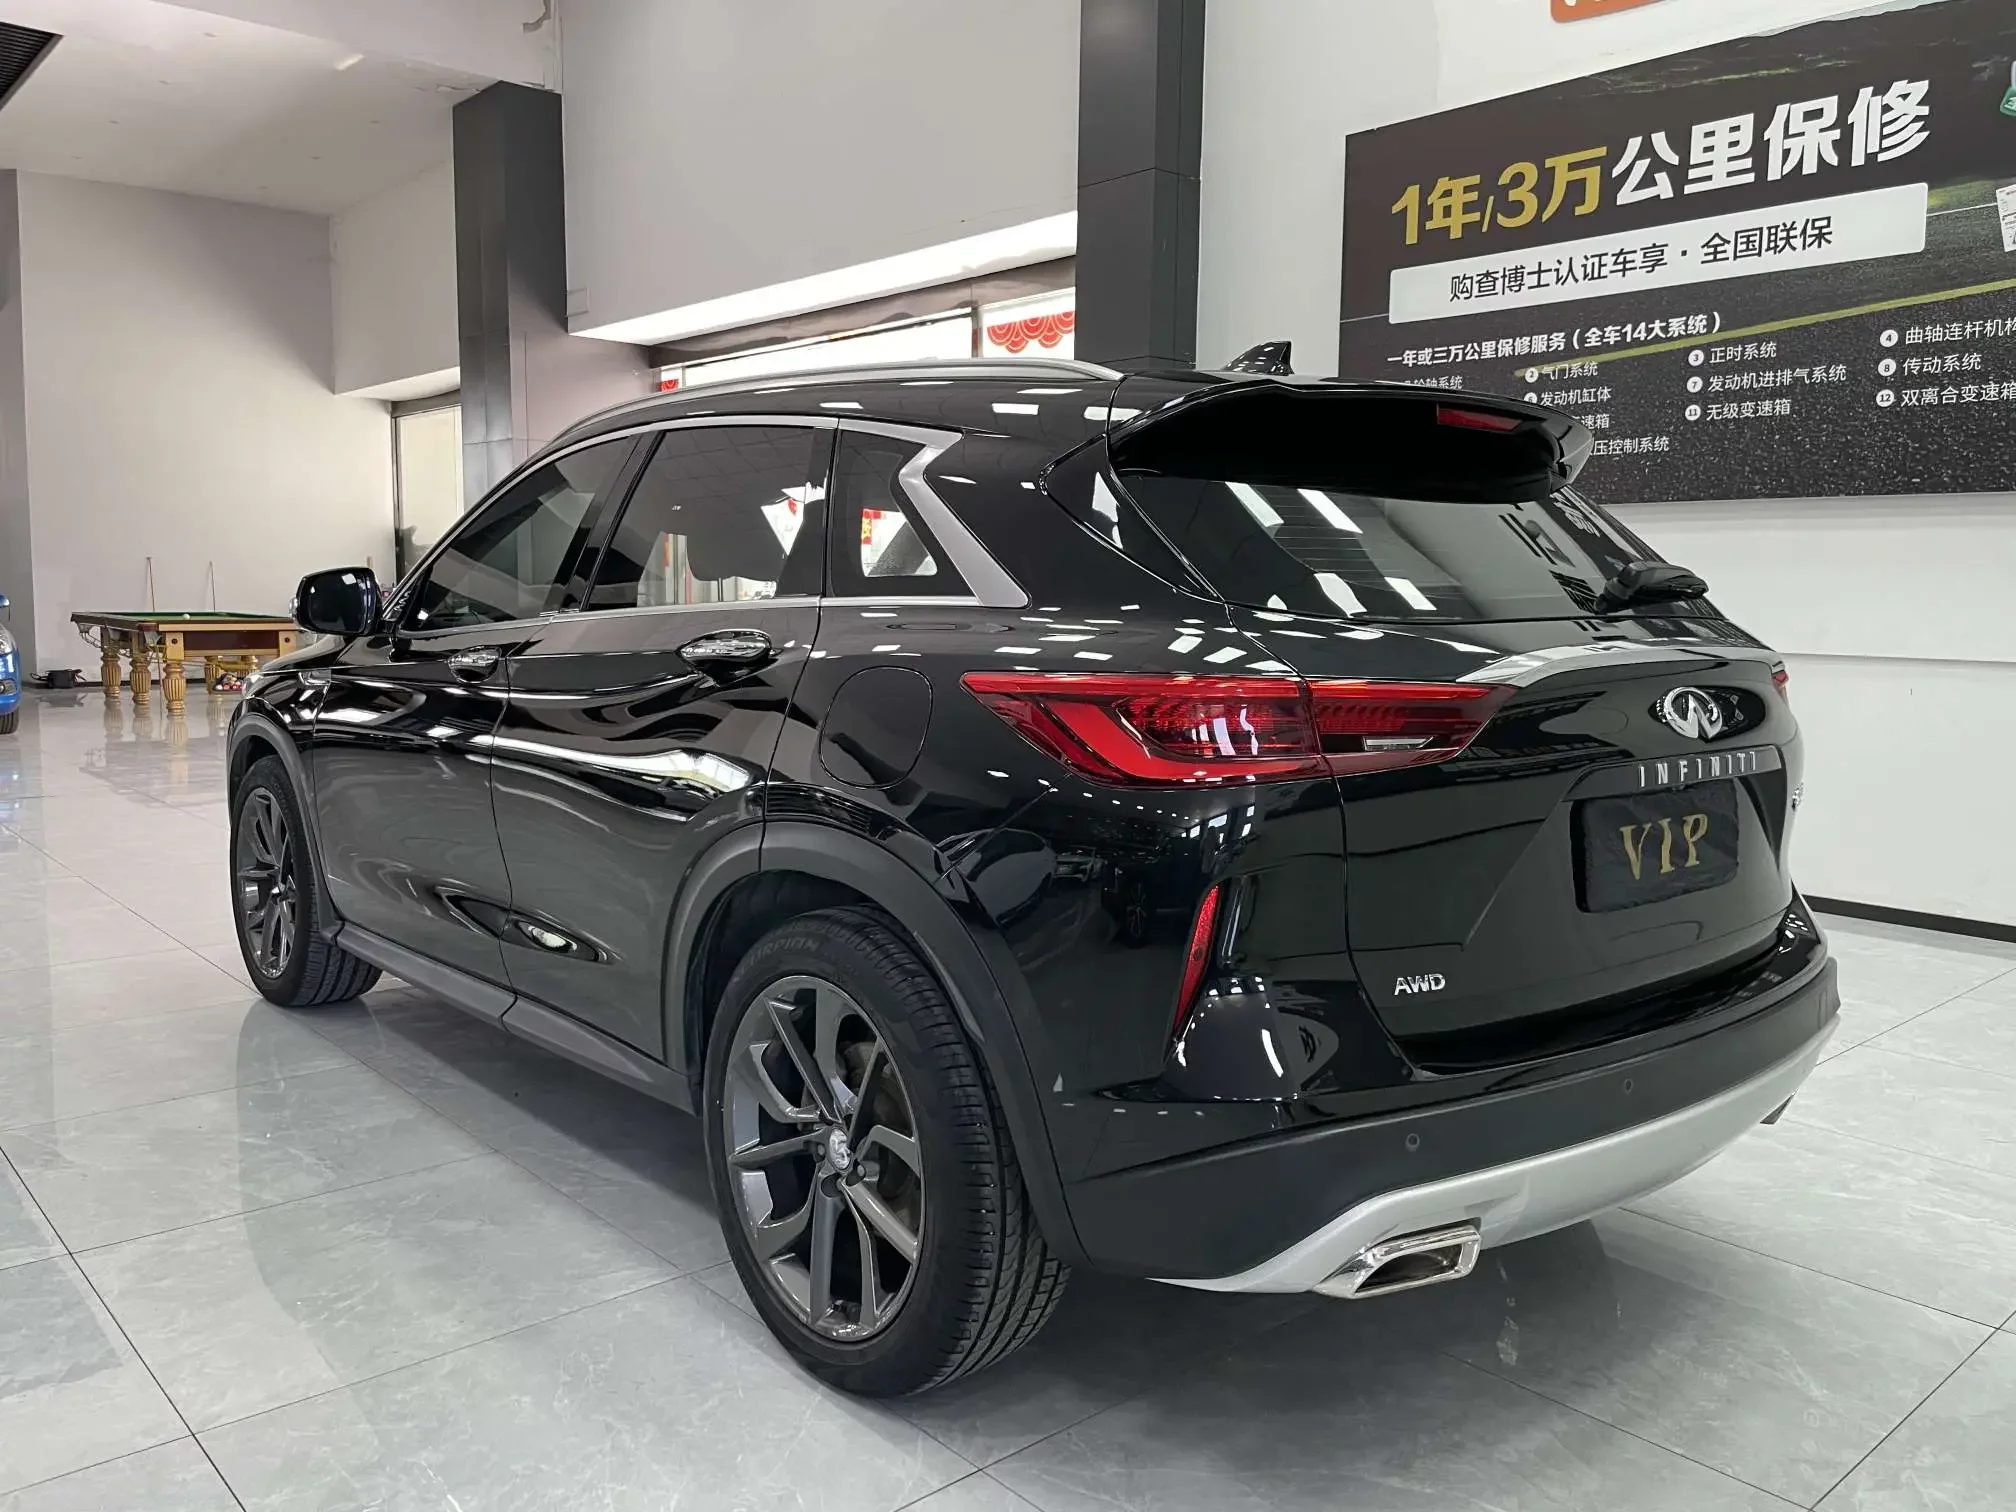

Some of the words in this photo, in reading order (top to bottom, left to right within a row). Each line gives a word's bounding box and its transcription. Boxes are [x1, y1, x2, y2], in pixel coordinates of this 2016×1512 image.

[1391, 79, 1931, 245] 1年/3万公里保修
[1709, 341, 1777, 364] 正时系统
[1903, 352, 1982, 376] 传动系统
[1542, 361, 1599, 380] 气门系统
[1707, 364, 1847, 392] 发动机进排气系统
[1540, 386, 1612, 406] 发动机缸体
[1901, 381, 2016, 407] 双离合变速箱
[1706, 399, 1792, 421] 无级变速箱
[1590, 436, 1670, 456] 压控制系统
[1638, 751, 1756, 787] INFINITI
[1619, 813, 1709, 880] VIP
[1394, 973, 1446, 995] AWD
